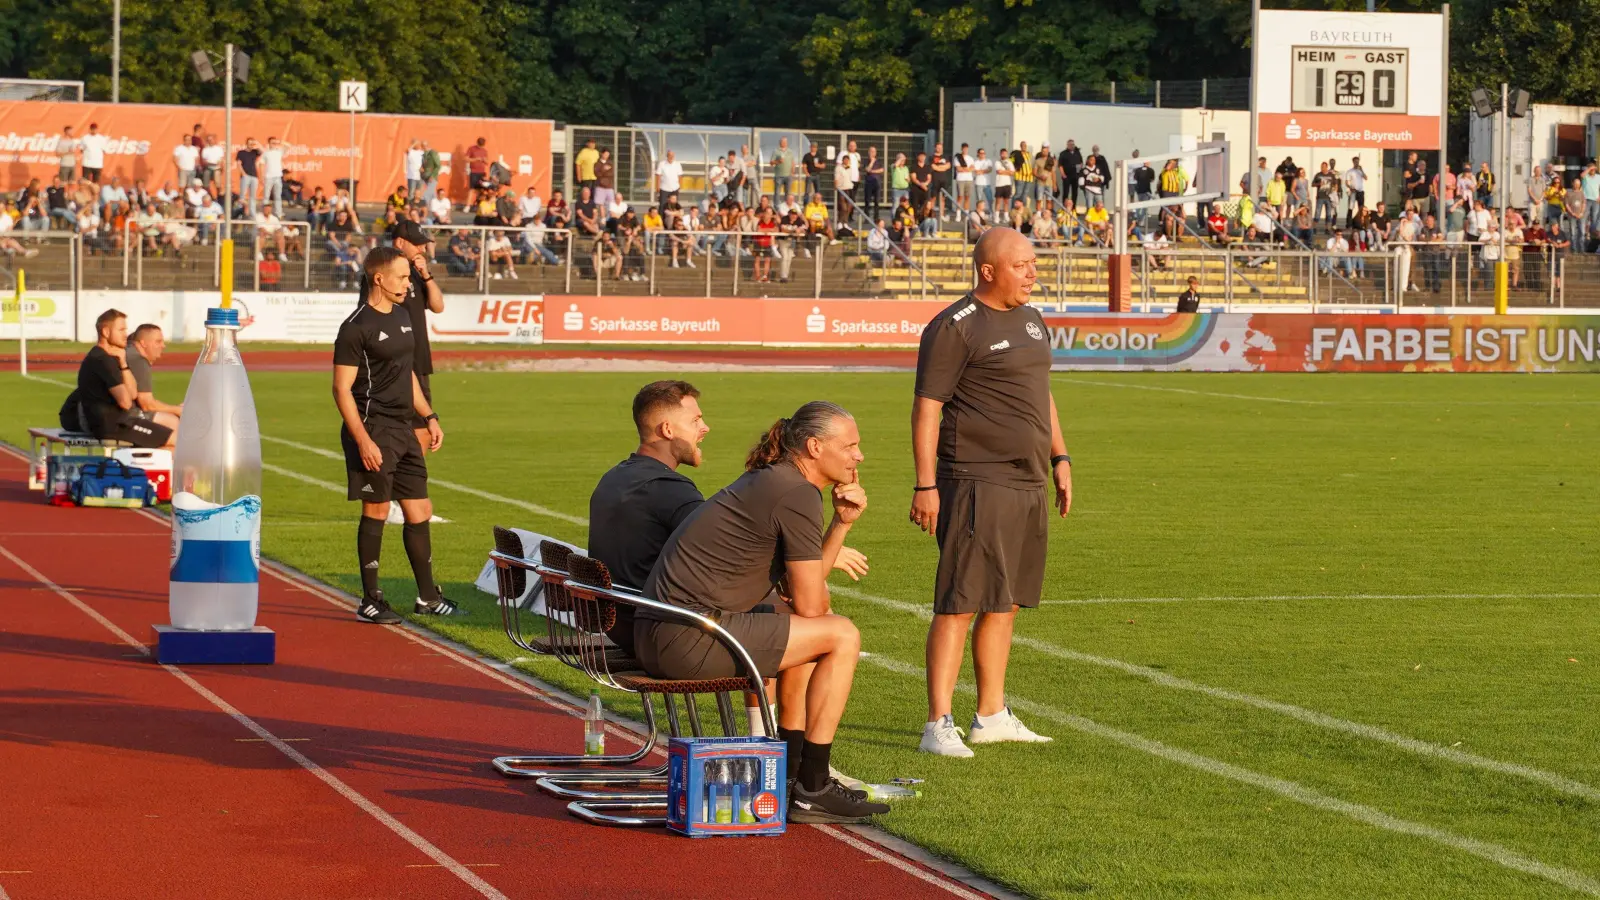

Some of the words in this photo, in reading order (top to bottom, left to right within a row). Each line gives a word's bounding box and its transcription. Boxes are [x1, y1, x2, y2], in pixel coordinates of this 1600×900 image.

[1310, 30, 1393, 44] BAYREUTH
[1297, 51, 1336, 63] HEIM
[1364, 52, 1405, 64] GAST
[1336, 73, 1365, 95] 29
[1372, 69, 1395, 108] 0
[346, 85, 360, 106] K
[1338, 95, 1361, 106] MIN
[1306, 128, 1361, 141] Sparkasse
[1363, 129, 1413, 143] Bayreuth
[477, 300, 544, 325] HER
[516, 326, 530, 337] Das
[590, 316, 658, 334] Sparkasse
[661, 318, 720, 334] Bayreuth
[831, 319, 898, 336] Sparkasse
[1084, 327, 1159, 351] color
[1311, 327, 1451, 362] FARBE
[1463, 328, 1527, 362] IST
[1538, 328, 1600, 363] UN
